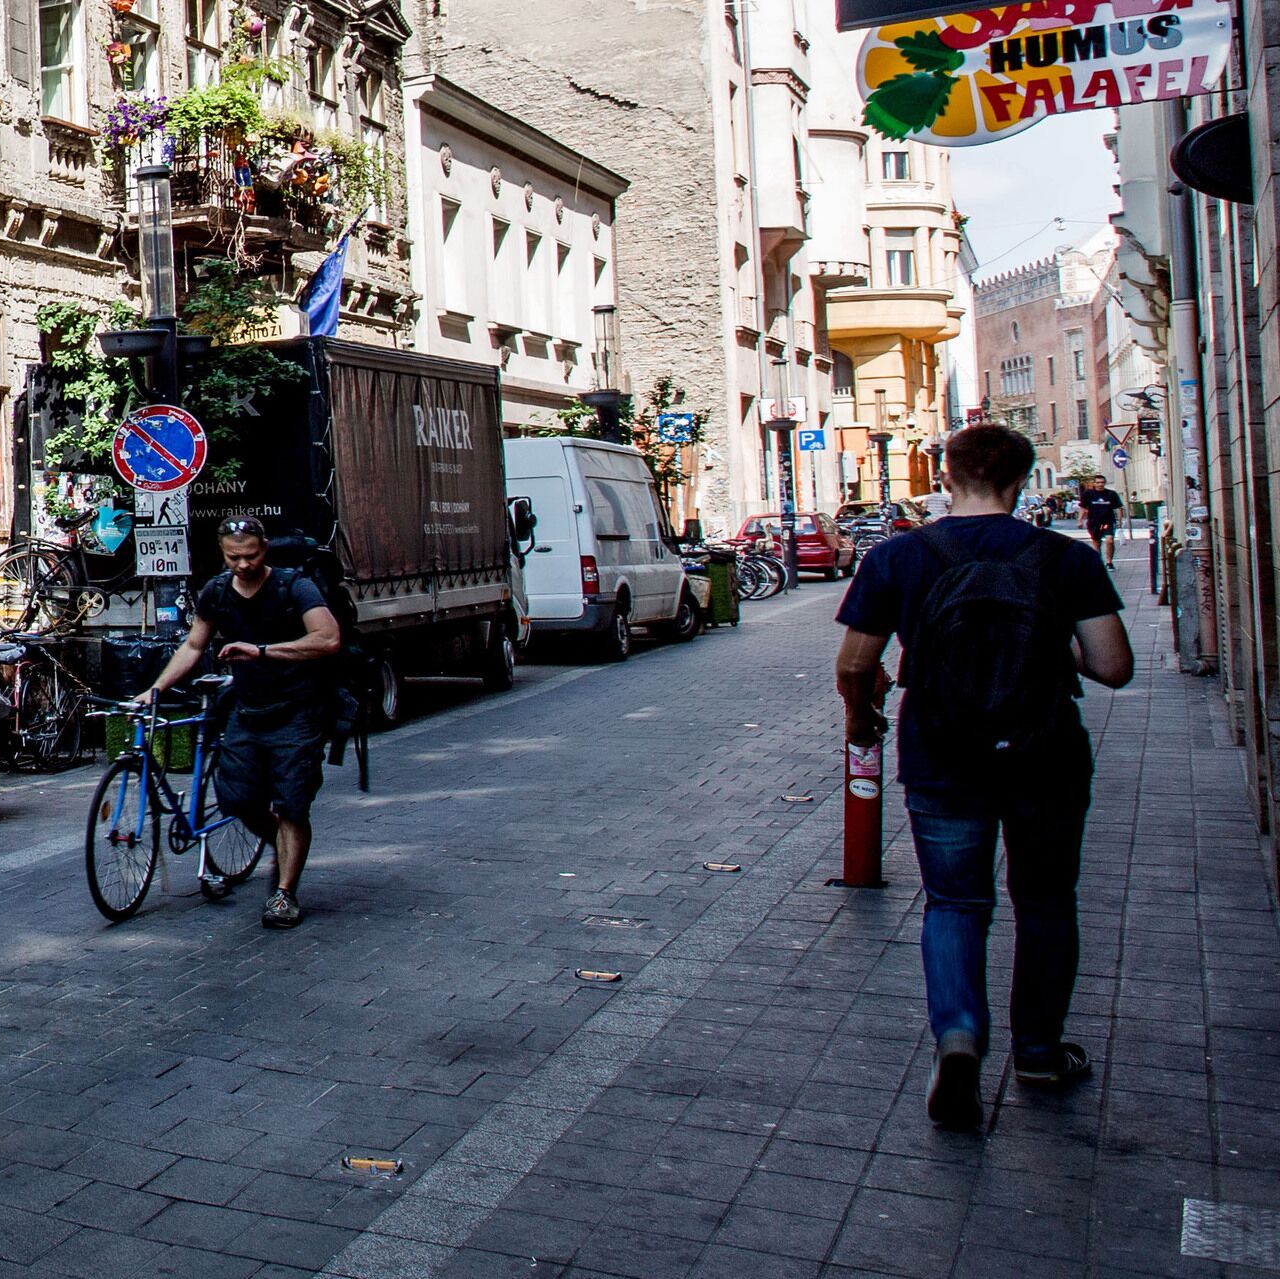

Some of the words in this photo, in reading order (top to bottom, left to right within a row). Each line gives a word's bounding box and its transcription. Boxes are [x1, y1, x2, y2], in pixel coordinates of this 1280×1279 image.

[989, 13, 1184, 75] HUMUS
[980, 55, 1217, 123] FALAFEL
[412, 404, 474, 450] RAIKER
